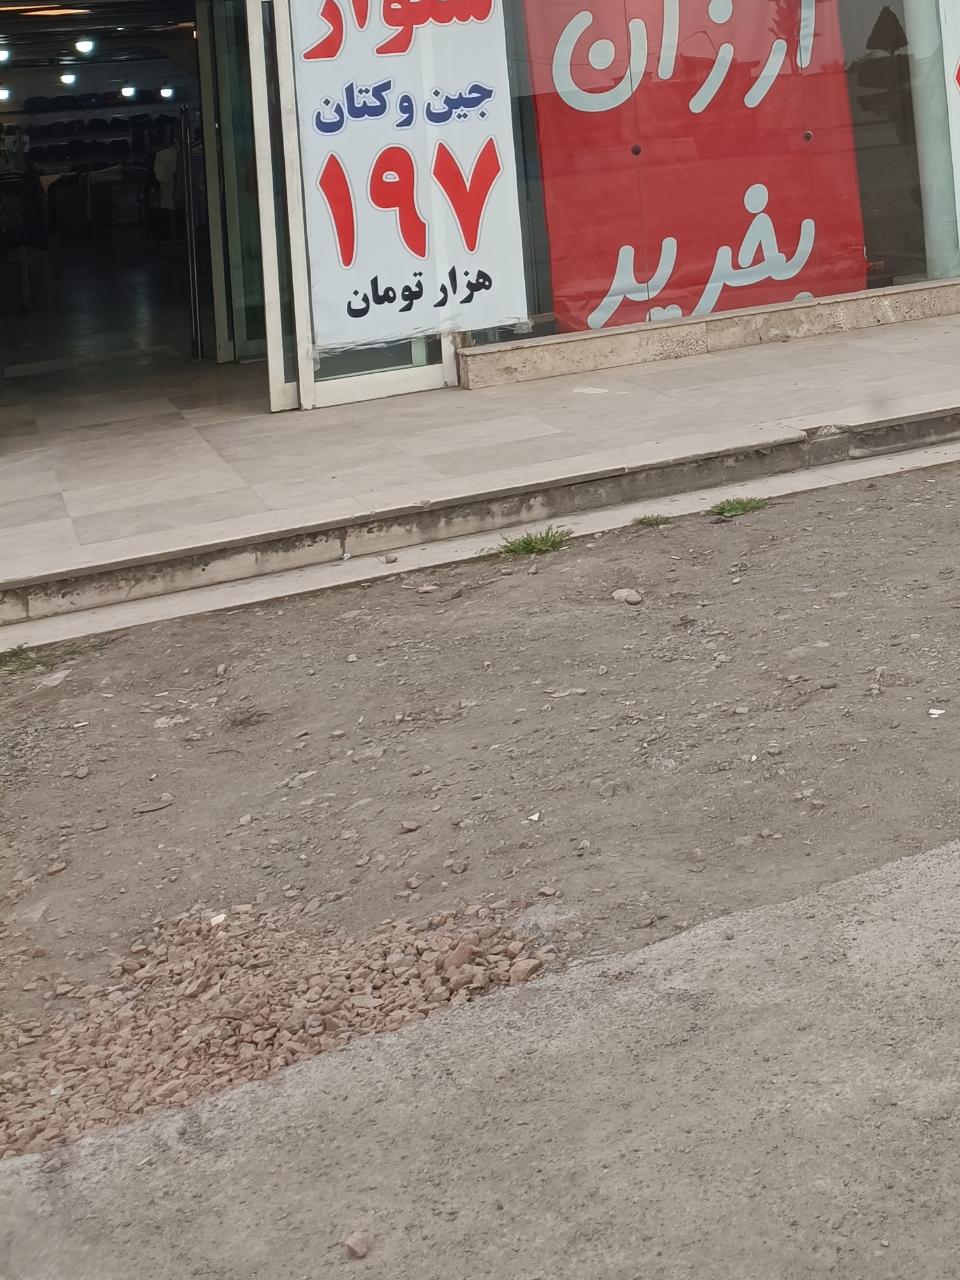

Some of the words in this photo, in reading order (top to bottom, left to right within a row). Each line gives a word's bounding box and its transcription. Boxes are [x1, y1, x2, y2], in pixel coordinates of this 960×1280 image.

[314, 79, 392, 134] کتان
[396, 93, 415, 128] و
[425, 80, 494, 124] جین
[317, 136, 501, 269] ۱۹۷
[346, 271, 424, 319] تومان
[433, 265, 493, 308] هزار
